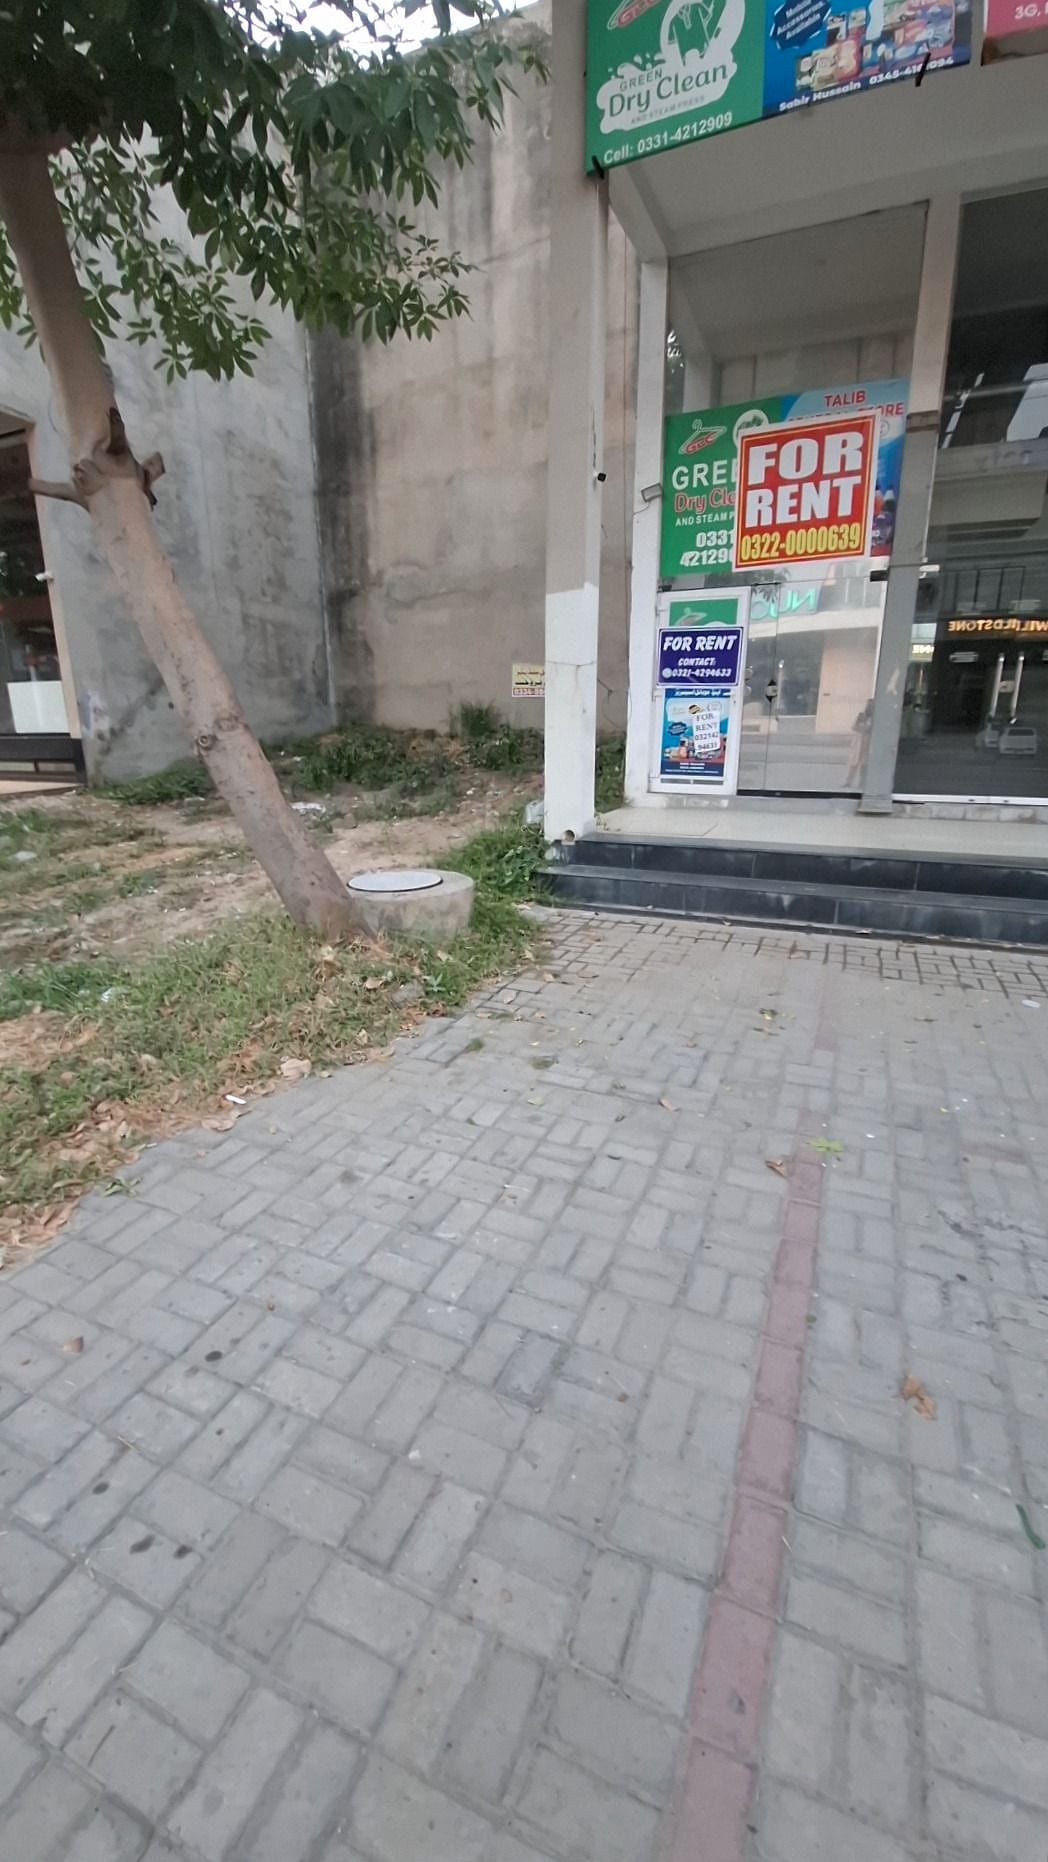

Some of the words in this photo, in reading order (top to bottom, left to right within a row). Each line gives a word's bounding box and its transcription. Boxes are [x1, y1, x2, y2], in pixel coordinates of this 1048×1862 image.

[609, 89, 650, 117] Dry
[656, 64, 728, 100] Clean
[619, 68, 663, 92] GREEN
[779, 94, 810, 112] Sabir
[812, 80, 862, 102] Hussain
[603, 144, 634, 165] Cell:
[637, 111, 734, 153] 0331-4212909
[824, 390, 867, 408] TALIB
[747, 431, 864, 486] FOR
[674, 492, 707, 515] Dry
[709, 487, 736, 508] Cle
[745, 475, 862, 529] RENT
[675, 516, 694, 527] AND
[695, 511, 727, 524] STEAM
[741, 522, 861, 561] 0322-0000639
[663, 636, 693, 651] FOR
[695, 635, 737, 651] RENT
[696, 713, 714, 721] FOR
